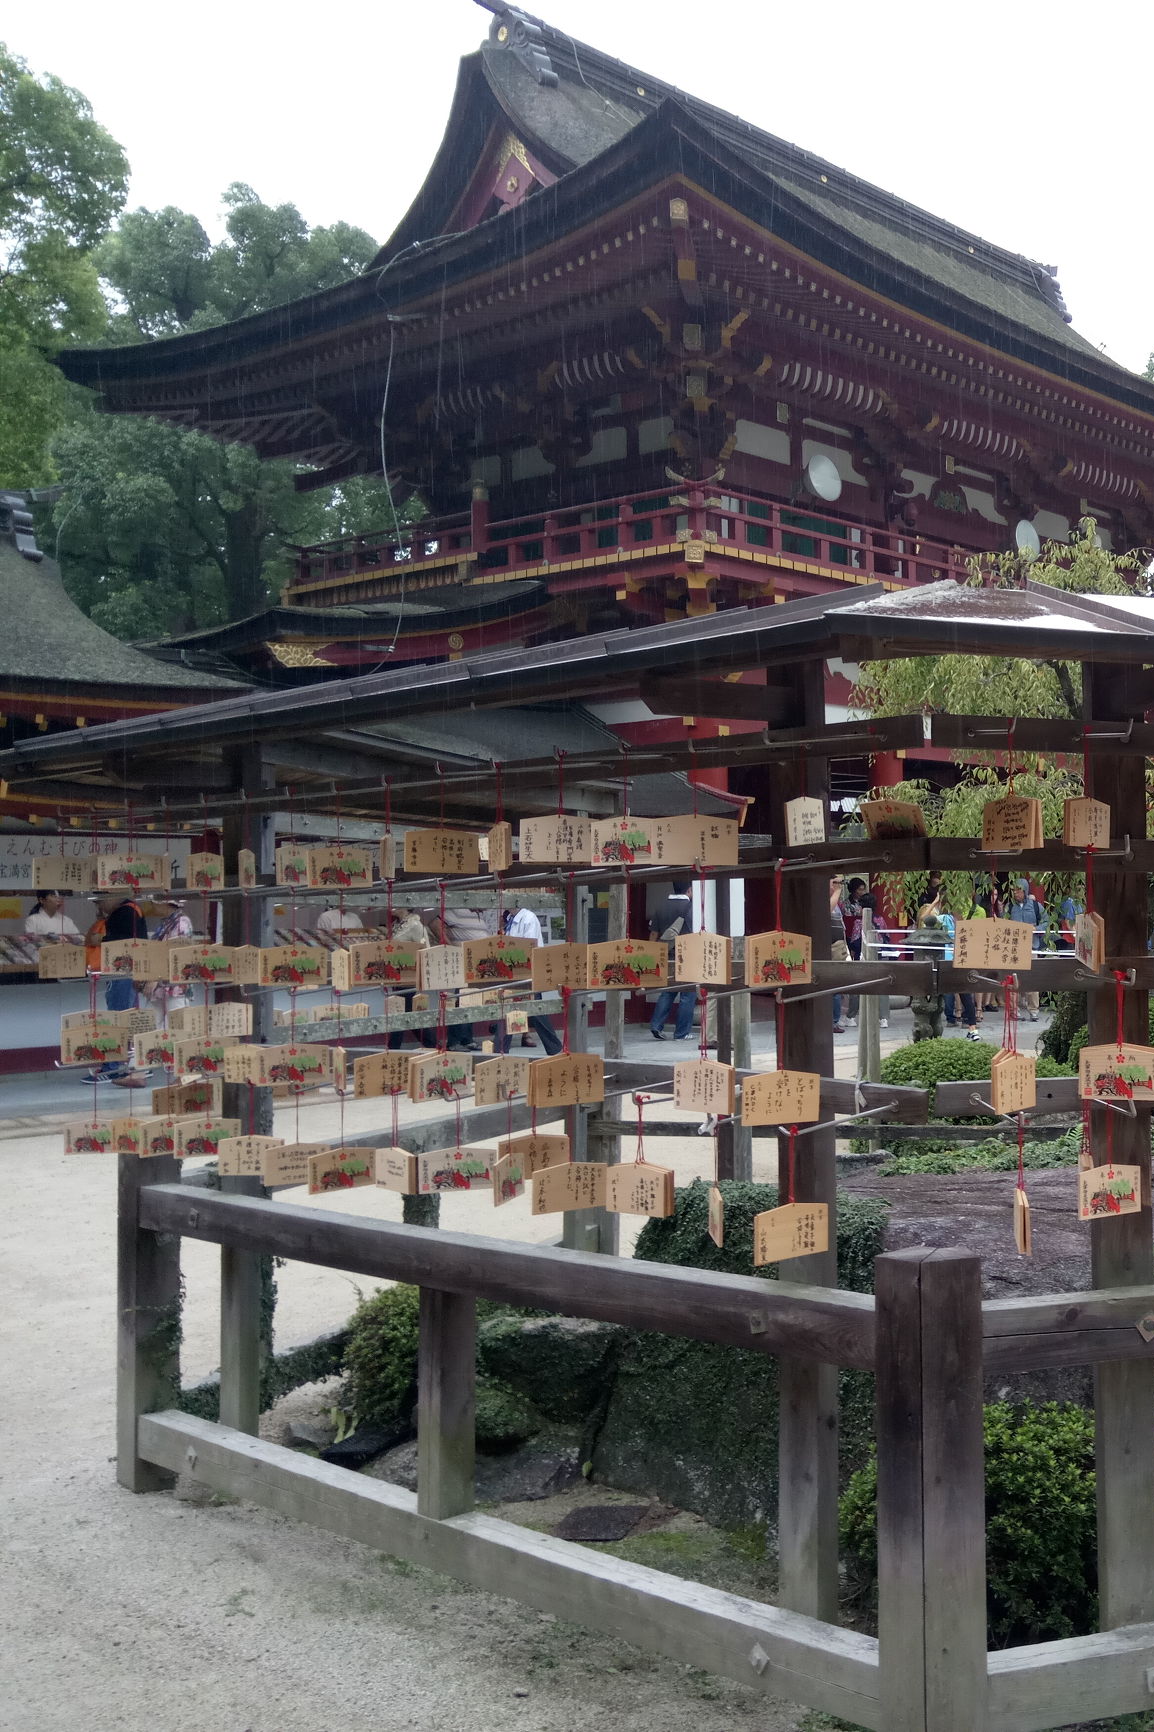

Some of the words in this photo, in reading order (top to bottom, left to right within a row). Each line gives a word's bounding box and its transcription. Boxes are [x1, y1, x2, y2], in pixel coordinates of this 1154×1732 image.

[6, 839, 118, 856] えんむすびの神
